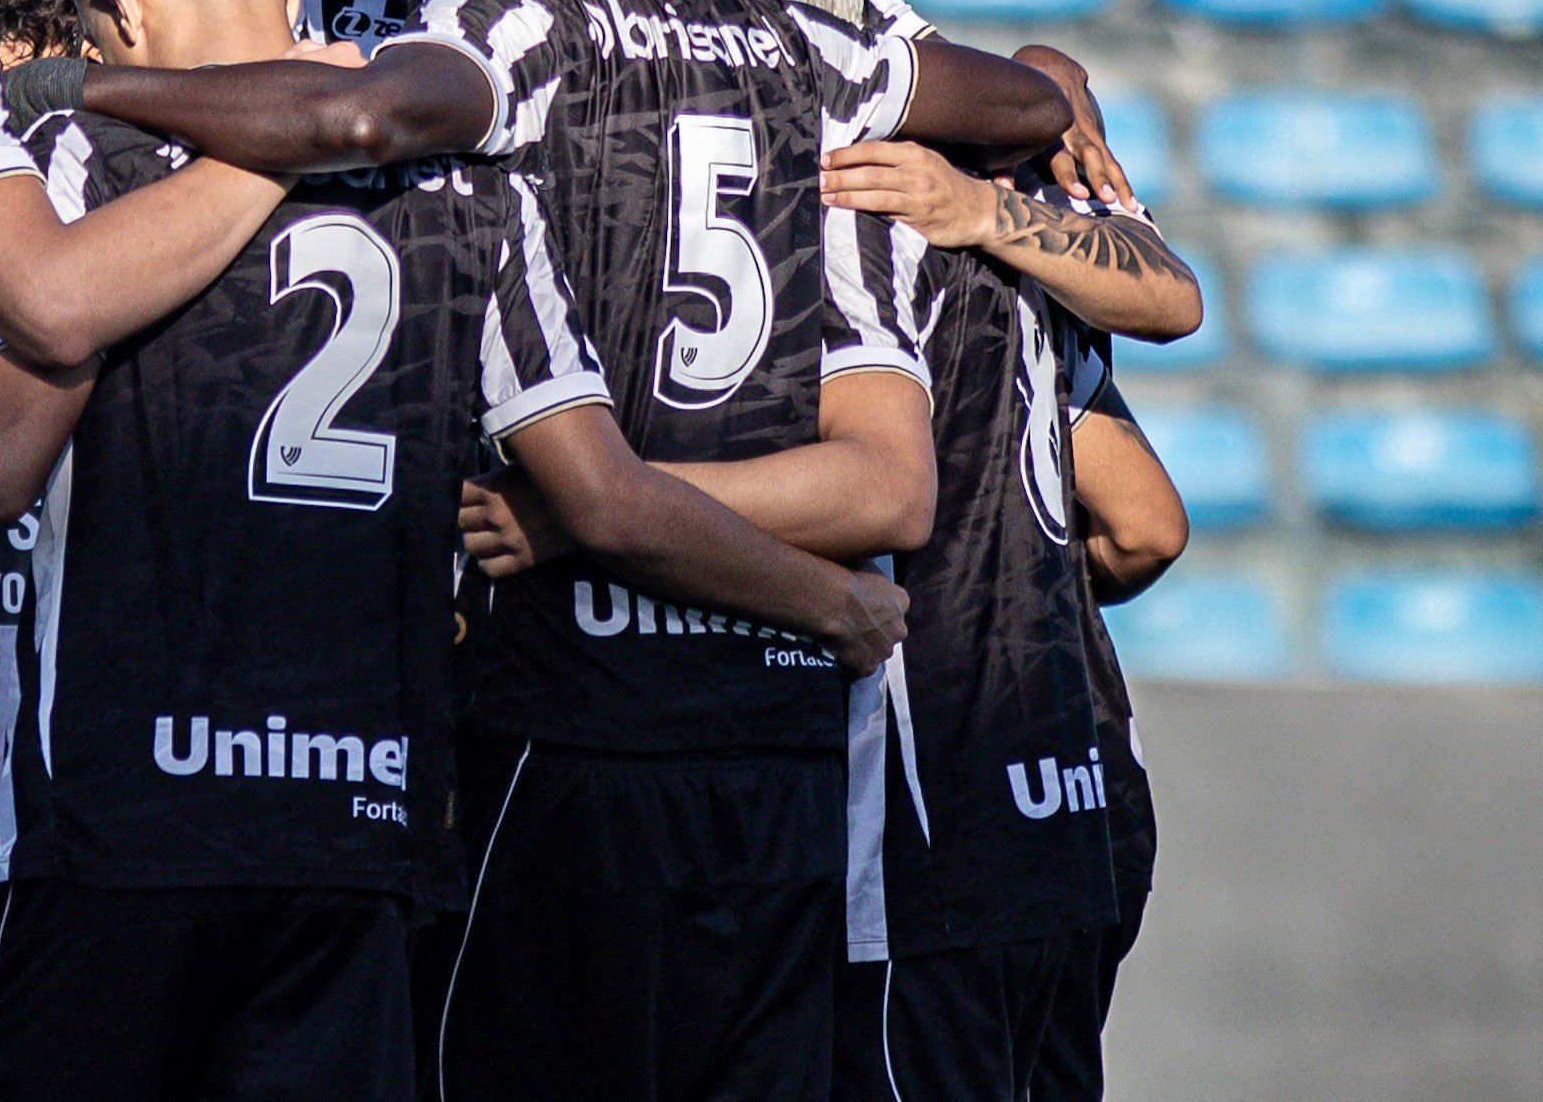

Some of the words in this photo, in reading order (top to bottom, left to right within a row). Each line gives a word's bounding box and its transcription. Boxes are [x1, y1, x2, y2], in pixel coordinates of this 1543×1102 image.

[247, 210, 401, 511] 2
[652, 114, 776, 410] 5
[153, 715, 409, 791] Unime
